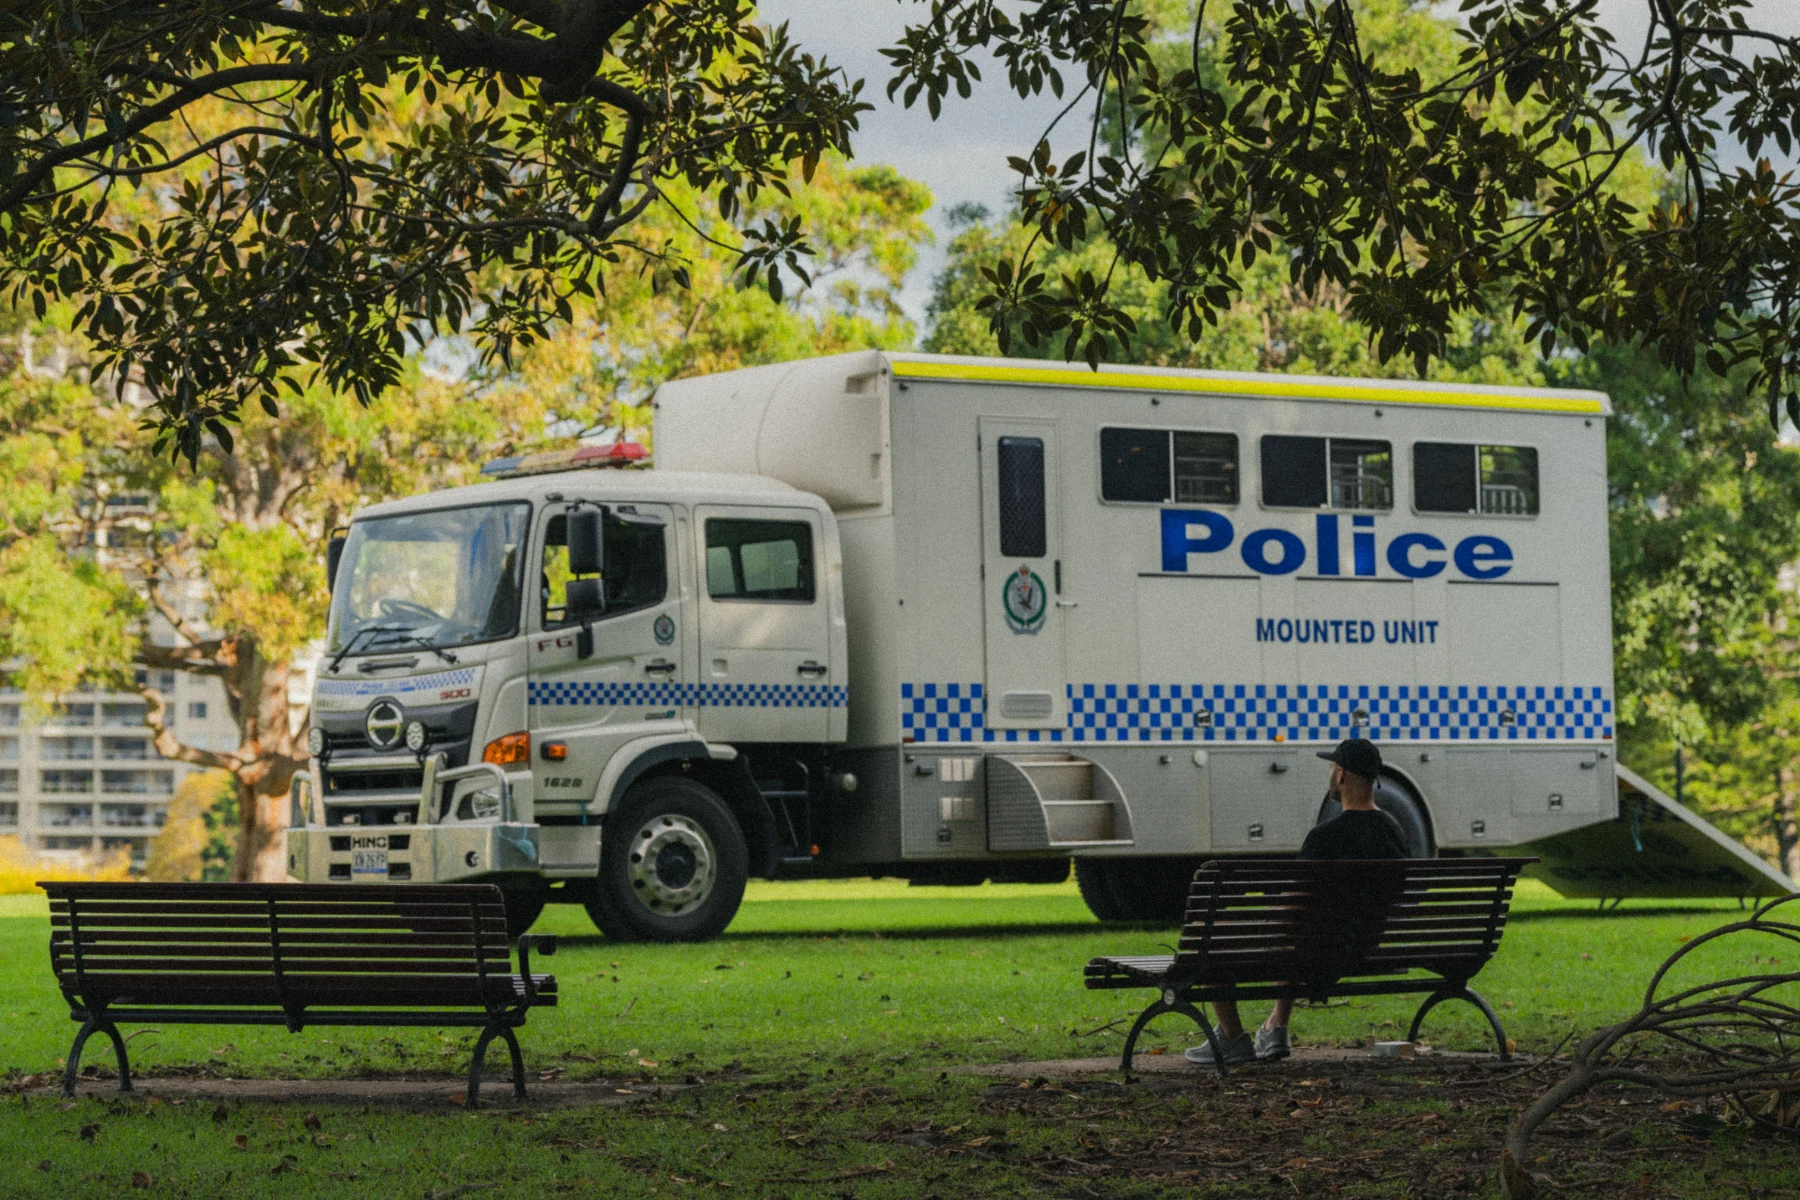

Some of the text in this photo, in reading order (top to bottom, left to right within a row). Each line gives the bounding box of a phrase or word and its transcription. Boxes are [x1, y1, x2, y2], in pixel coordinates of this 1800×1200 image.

[1160, 508, 1514, 580] Police
[1256, 617, 1439, 644] MOUNTED UNIT
[537, 635, 573, 651] FG
[439, 688, 472, 700] 500
[352, 836, 387, 848] HINO
